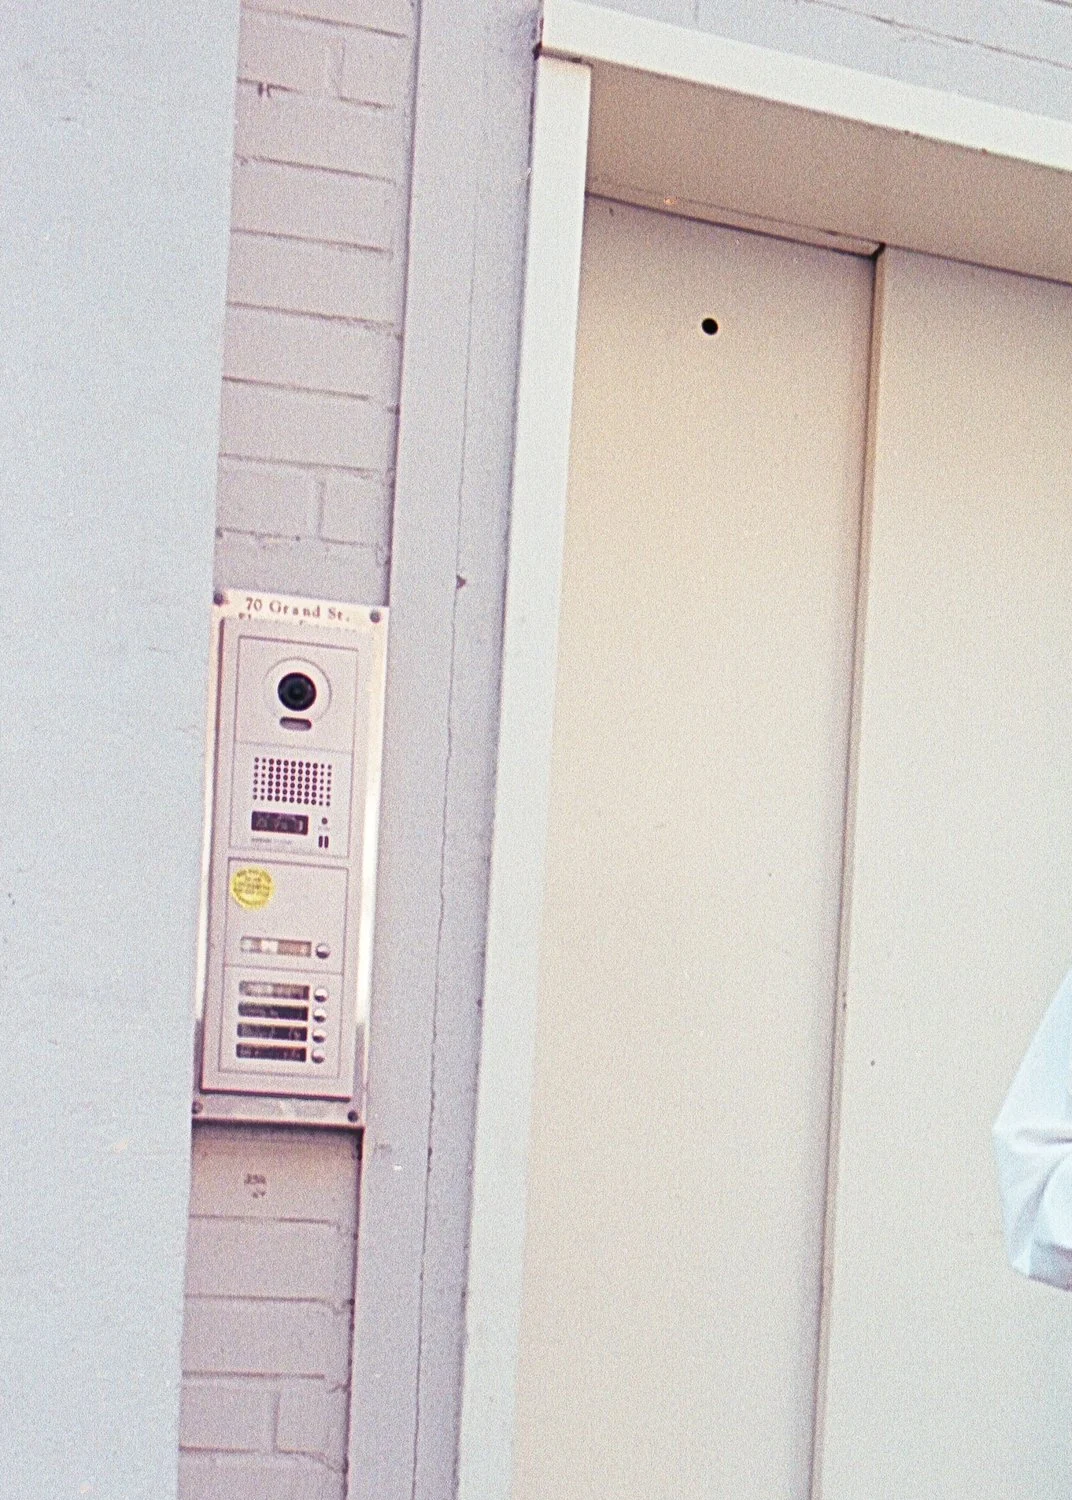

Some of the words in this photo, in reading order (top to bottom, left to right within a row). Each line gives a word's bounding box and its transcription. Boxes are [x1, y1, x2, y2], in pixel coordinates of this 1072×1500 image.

[246, 597, 262, 611] 70
[269, 600, 320, 618] Grand
[328, 607, 350, 621] St.
